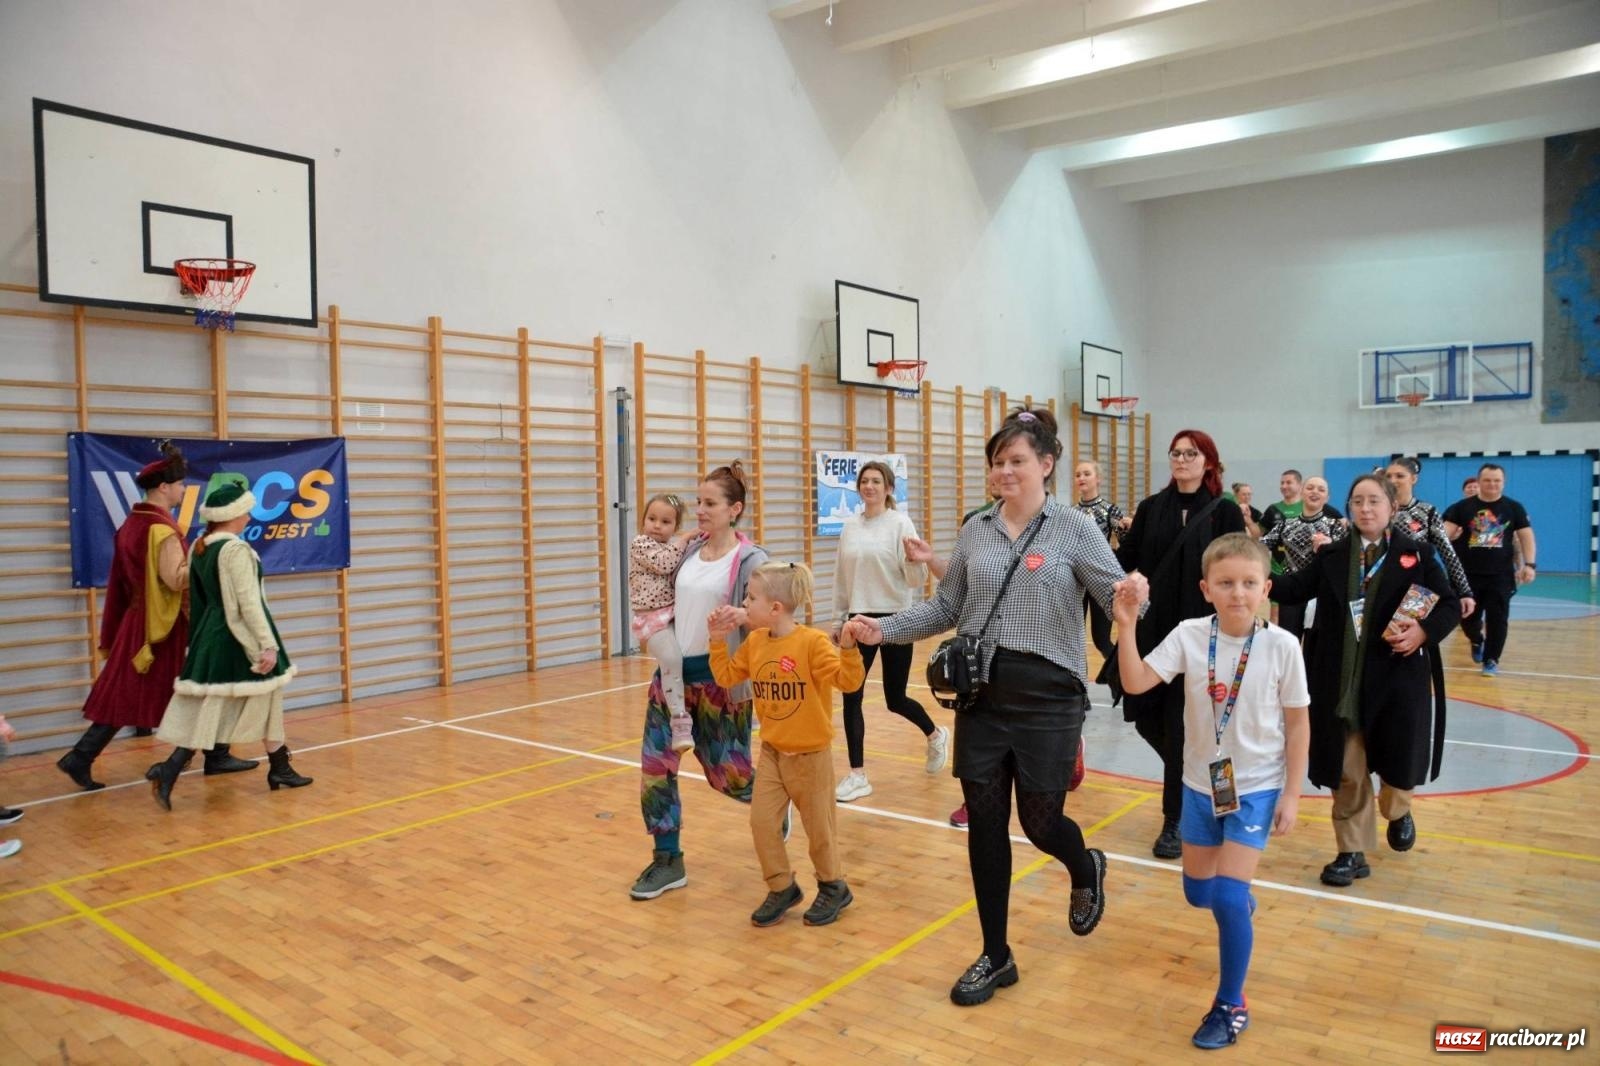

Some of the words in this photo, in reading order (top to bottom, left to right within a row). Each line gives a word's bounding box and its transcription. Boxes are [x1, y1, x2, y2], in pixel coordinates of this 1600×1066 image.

[825, 458, 857, 476] FERIE
[264, 523, 312, 540] JEST
[753, 681, 807, 701] DETROIT
